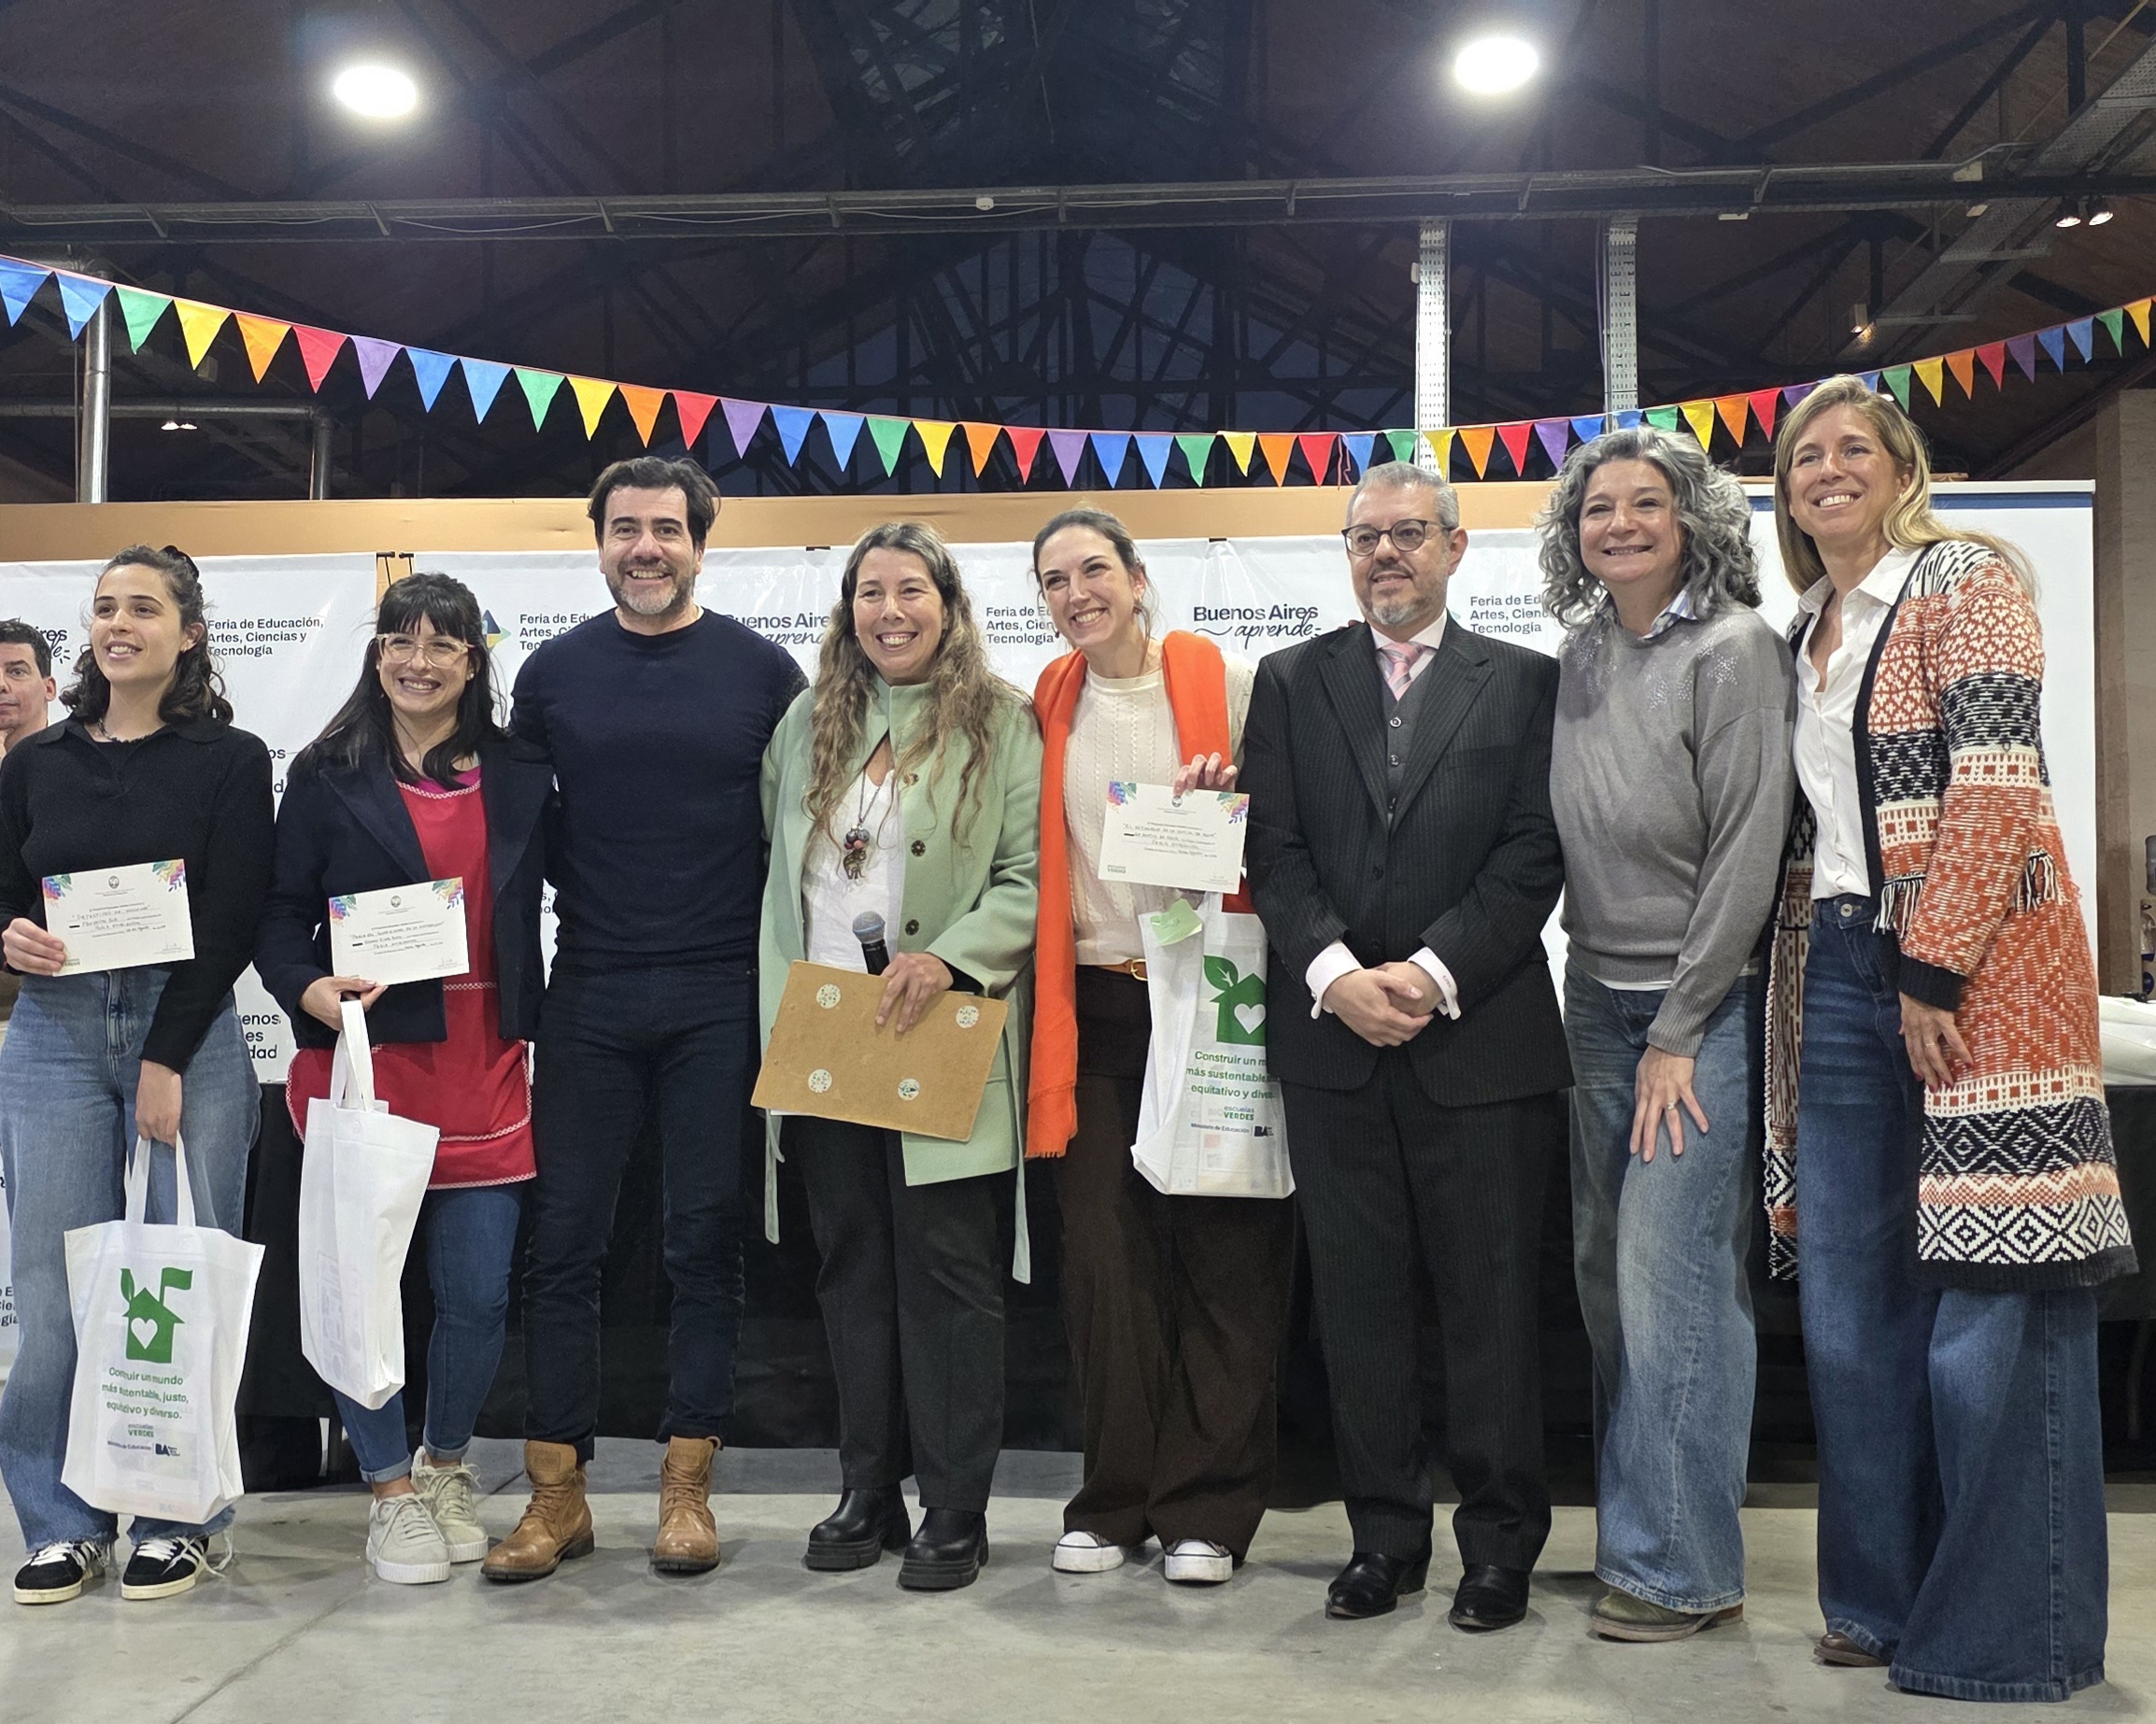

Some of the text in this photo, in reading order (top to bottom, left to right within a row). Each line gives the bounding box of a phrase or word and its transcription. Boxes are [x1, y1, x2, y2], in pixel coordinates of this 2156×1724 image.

[1470, 596, 1502, 606] Feria
[1505, 595, 1521, 605] de
[986, 606, 1016, 616] Feria
[1019, 606, 1034, 616] de
[1194, 604, 1318, 621] Buenos Aires
[1470, 610, 1509, 620] Artes,
[207, 617, 323, 629] Feria de Educación,
[519, 614, 550, 624] Feria
[552, 614, 567, 624] de
[986, 620, 1023, 631] Artes,
[1234, 613, 1315, 650] aprende
[1470, 622, 1542, 634] Tecnología
[208, 631, 306, 643] Artes, Ciencias y
[986, 633, 1054, 645] Tecnología
[208, 644, 273, 657] Tecnología
[1195, 1051, 1241, 1064] Construir
[1186, 1067, 1206, 1077] más
[1191, 1084, 1241, 1096] equitativo
[1242, 1091, 1249, 1099] y
[1224, 1111, 1255, 1121] VERDES
[163, 1392, 189, 1404] justo,
[143, 1407, 149, 1416] y
